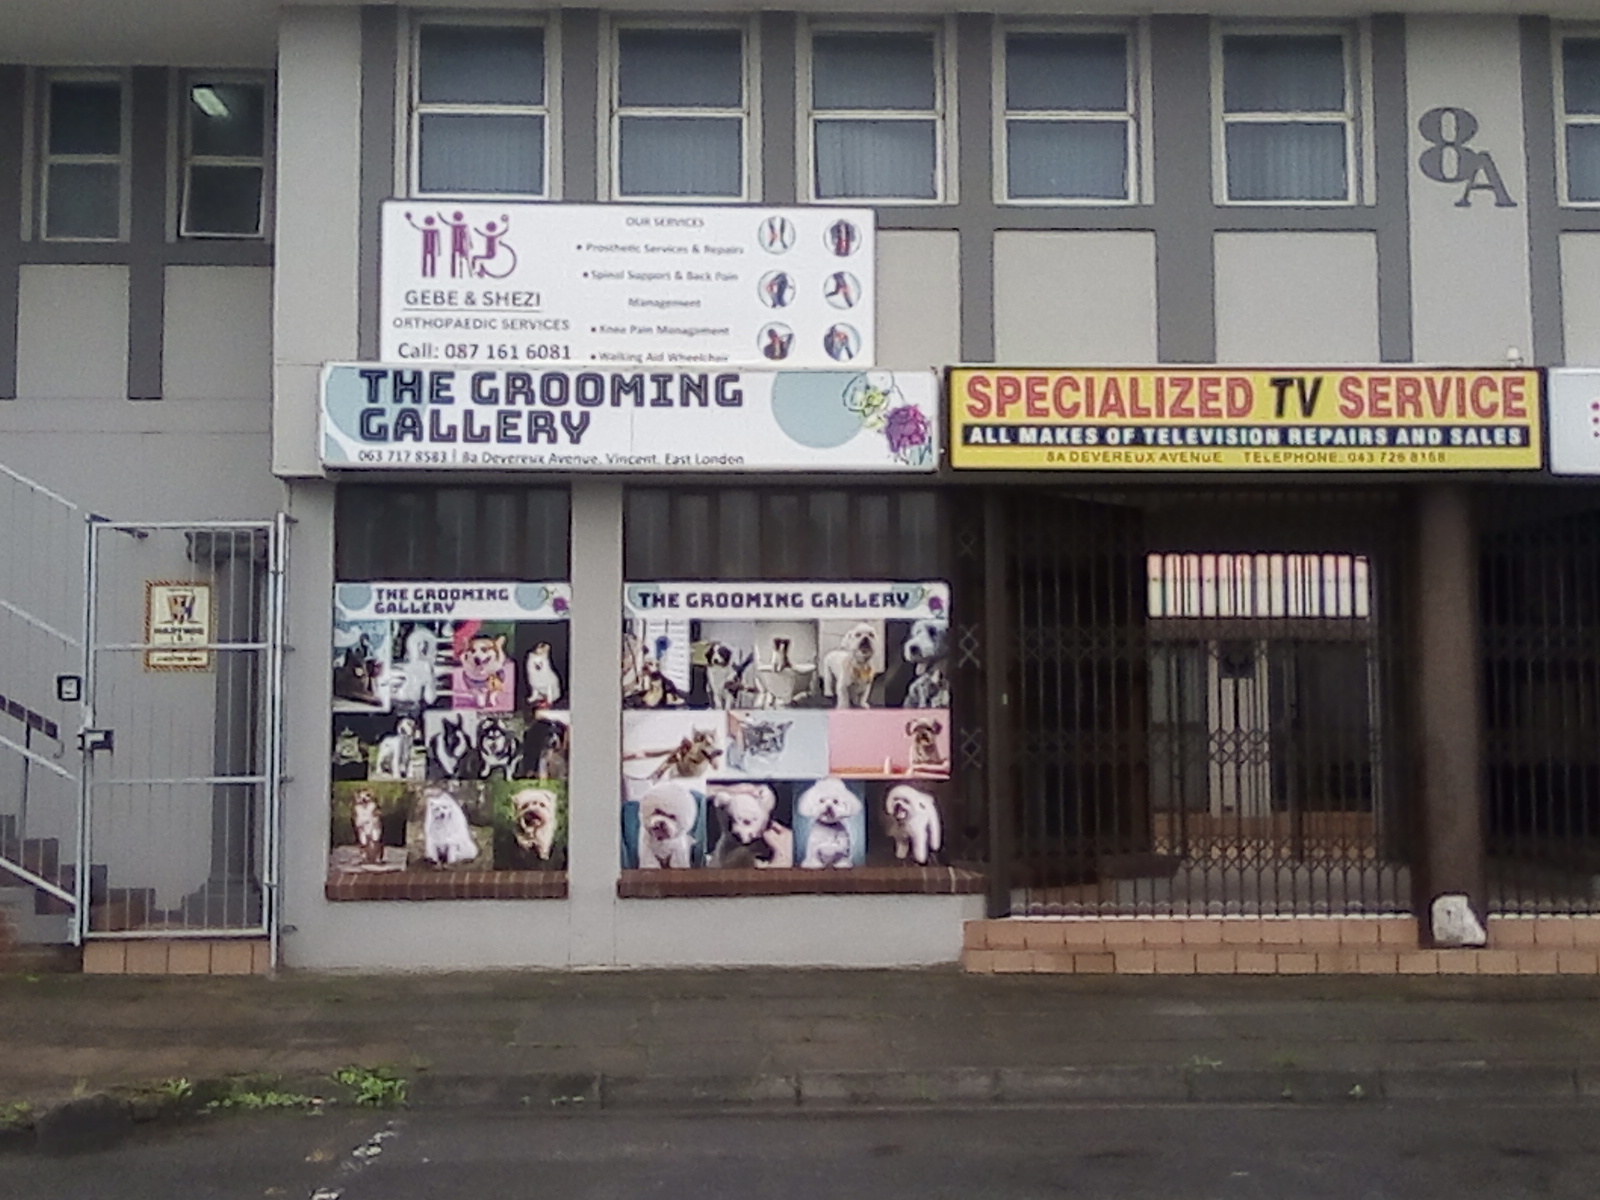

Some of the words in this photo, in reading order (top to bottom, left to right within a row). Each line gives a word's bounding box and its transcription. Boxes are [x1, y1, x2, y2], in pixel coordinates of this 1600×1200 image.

[626, 216, 650, 227] OUR
[654, 217, 705, 228] SERVICES
[586, 242, 640, 253] Prosthetic
[644, 243, 688, 254] Services
[692, 244, 700, 254] &
[704, 244, 744, 256] Repairs
[628, 270, 671, 281] Support
[674, 270, 683, 280] &
[686, 270, 712, 281] Back
[404, 289, 459, 306] GEBE
[464, 290, 477, 307] &
[482, 291, 541, 307] SHEZI
[392, 316, 498, 330] ORTHOPAEDIC
[501, 318, 570, 331] SERVICES
[656, 325, 729, 337] Management
[398, 342, 439, 359] Call:
[445, 344, 479, 360] 087
[487, 344, 518, 361] 161
[526, 344, 571, 361] 6081
[358, 369, 455, 405] THE
[470, 370, 743, 408] GROOMING
[966, 375, 1254, 418] SPECIALIZED
[1269, 377, 1324, 418] TV
[1338, 376, 1527, 418] SERVICE
[358, 407, 590, 445] GALLERY
[969, 427, 1011, 444] ALL
[1018, 427, 1099, 444] MAKES
[1106, 427, 1136, 444] OF
[1143, 427, 1279, 445] TELEVISION
[1288, 427, 1388, 445] REPAIRS
[1396, 427, 1443, 445] AND
[1450, 427, 1522, 445] SALES
[358, 450, 382, 462] 063
[388, 450, 411, 462] 717
[415, 450, 447, 463] 8583
[482, 451, 545, 465] Devereux
[664, 453, 691, 465] East
[695, 452, 745, 465] London
[1069, 451, 1155, 463] DEVEREUX
[1158, 451, 1223, 463] AVENUE
[1347, 451, 1375, 463] 043
[374, 588, 409, 601] THE
[414, 588, 509, 601] GROOMING
[639, 592, 680, 609] THE
[686, 592, 804, 609] GROOMING
[811, 592, 911, 609] GALLERY
[374, 602, 455, 614] GALLERY
